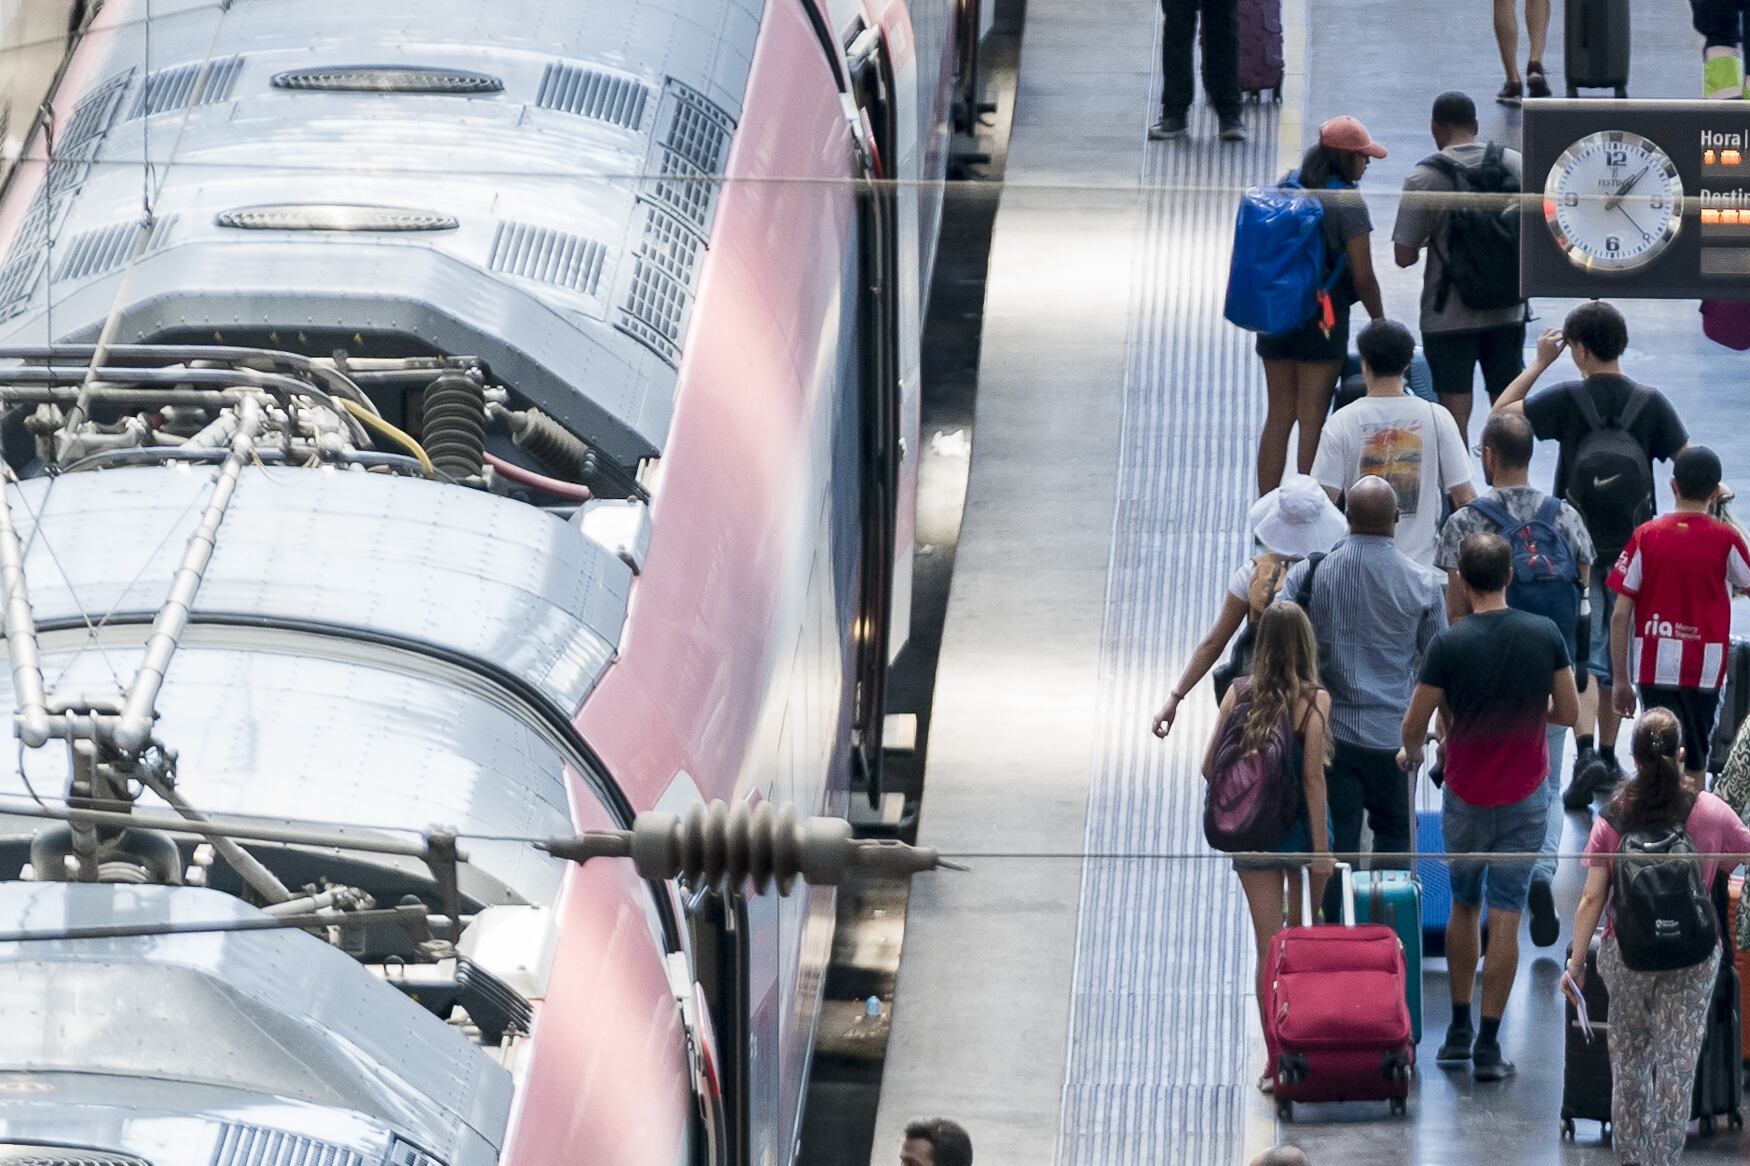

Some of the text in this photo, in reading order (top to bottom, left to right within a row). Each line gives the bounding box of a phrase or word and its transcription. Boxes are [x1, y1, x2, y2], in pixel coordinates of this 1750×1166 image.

[1700, 130, 1741, 147] Hora
[1606, 151, 1627, 167] 12
[1605, 236, 1620, 251] 6
[1644, 612, 1673, 637] ria
